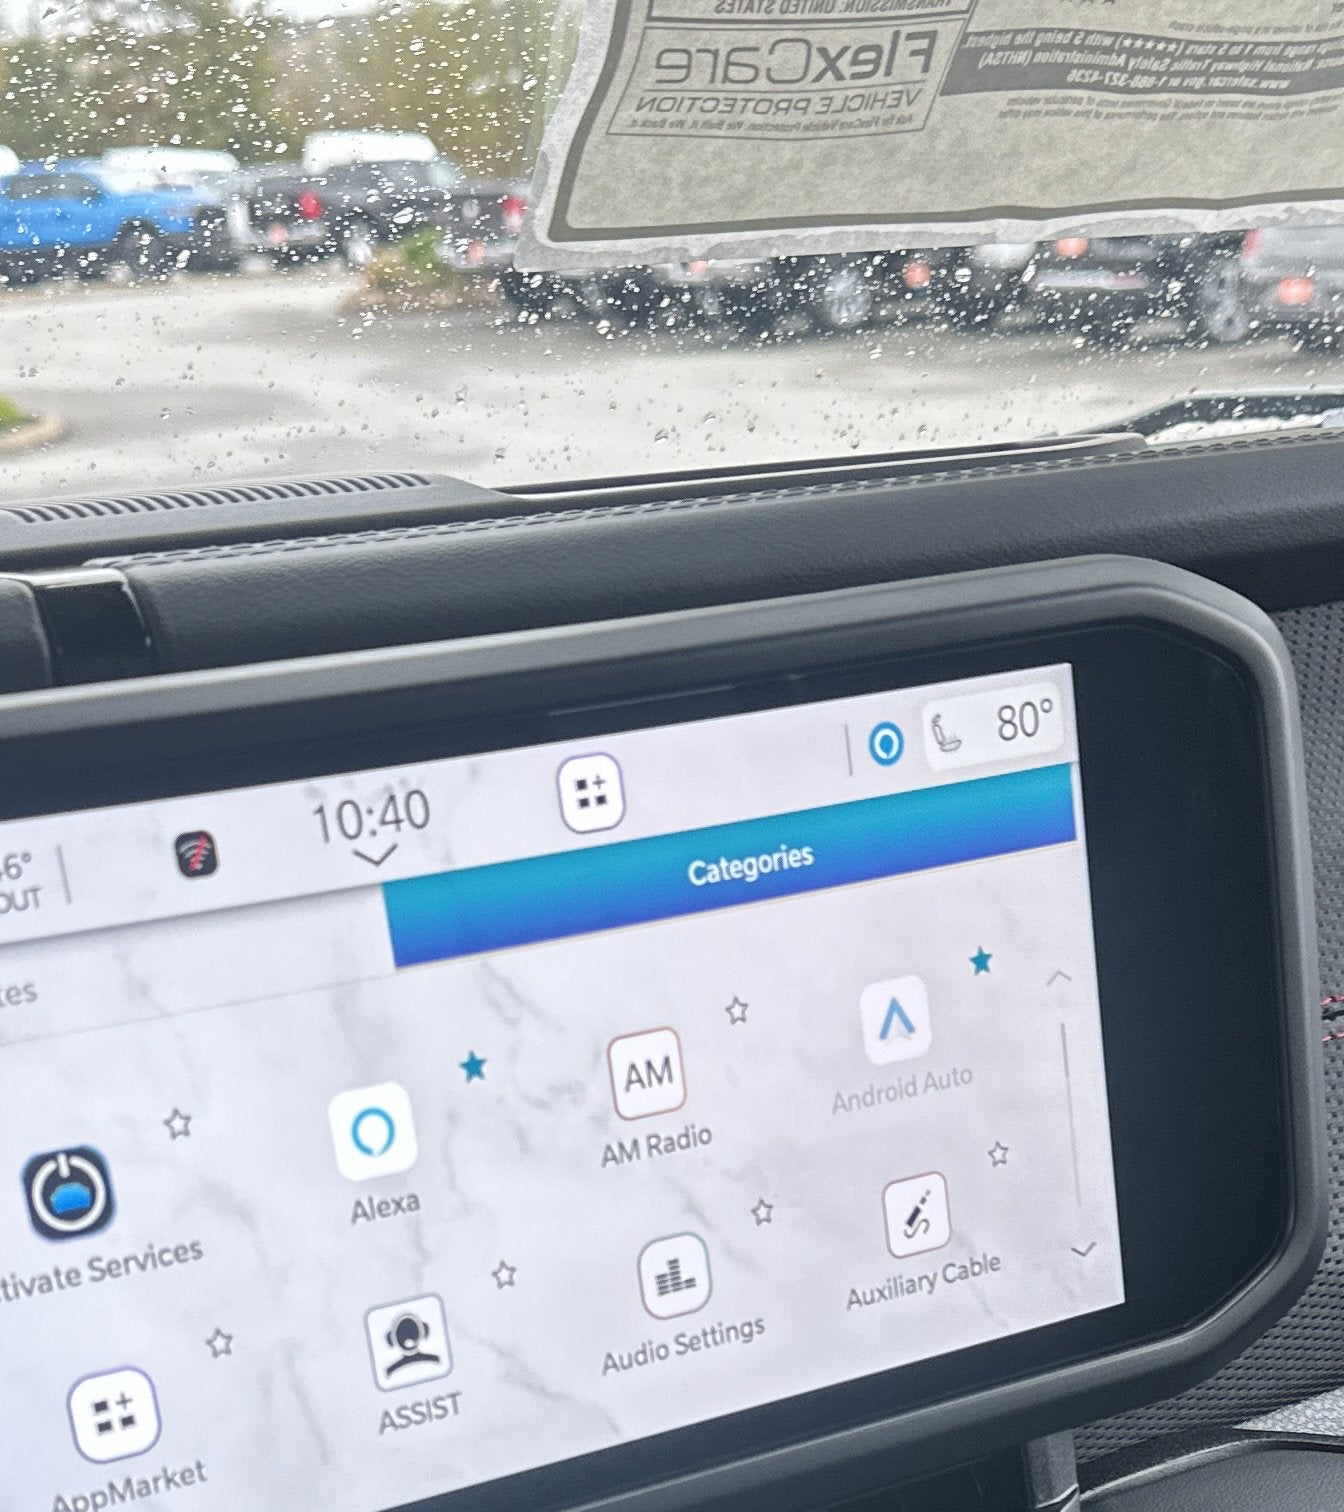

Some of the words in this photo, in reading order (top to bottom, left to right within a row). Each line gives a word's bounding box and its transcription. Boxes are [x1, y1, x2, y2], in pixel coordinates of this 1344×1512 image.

[996, 697, 1054, 743] 80°
[313, 787, 433, 844] 10:40
[686, 843, 817, 889] Categories
[624, 1055, 675, 1094] AM
[831, 1077, 919, 1116] Android
[922, 1064, 973, 1095] Auto
[601, 1139, 641, 1170] AM
[645, 1123, 713, 1158] Radio
[349, 1191, 422, 1226] Alexa
[87, 1239, 205, 1285] Services
[846, 1270, 939, 1312] Auxiliary
[941, 1253, 1003, 1285] Cable
[601, 1341, 670, 1376] Audio
[674, 1315, 767, 1357] Settings
[377, 1390, 464, 1436] ASSIST
